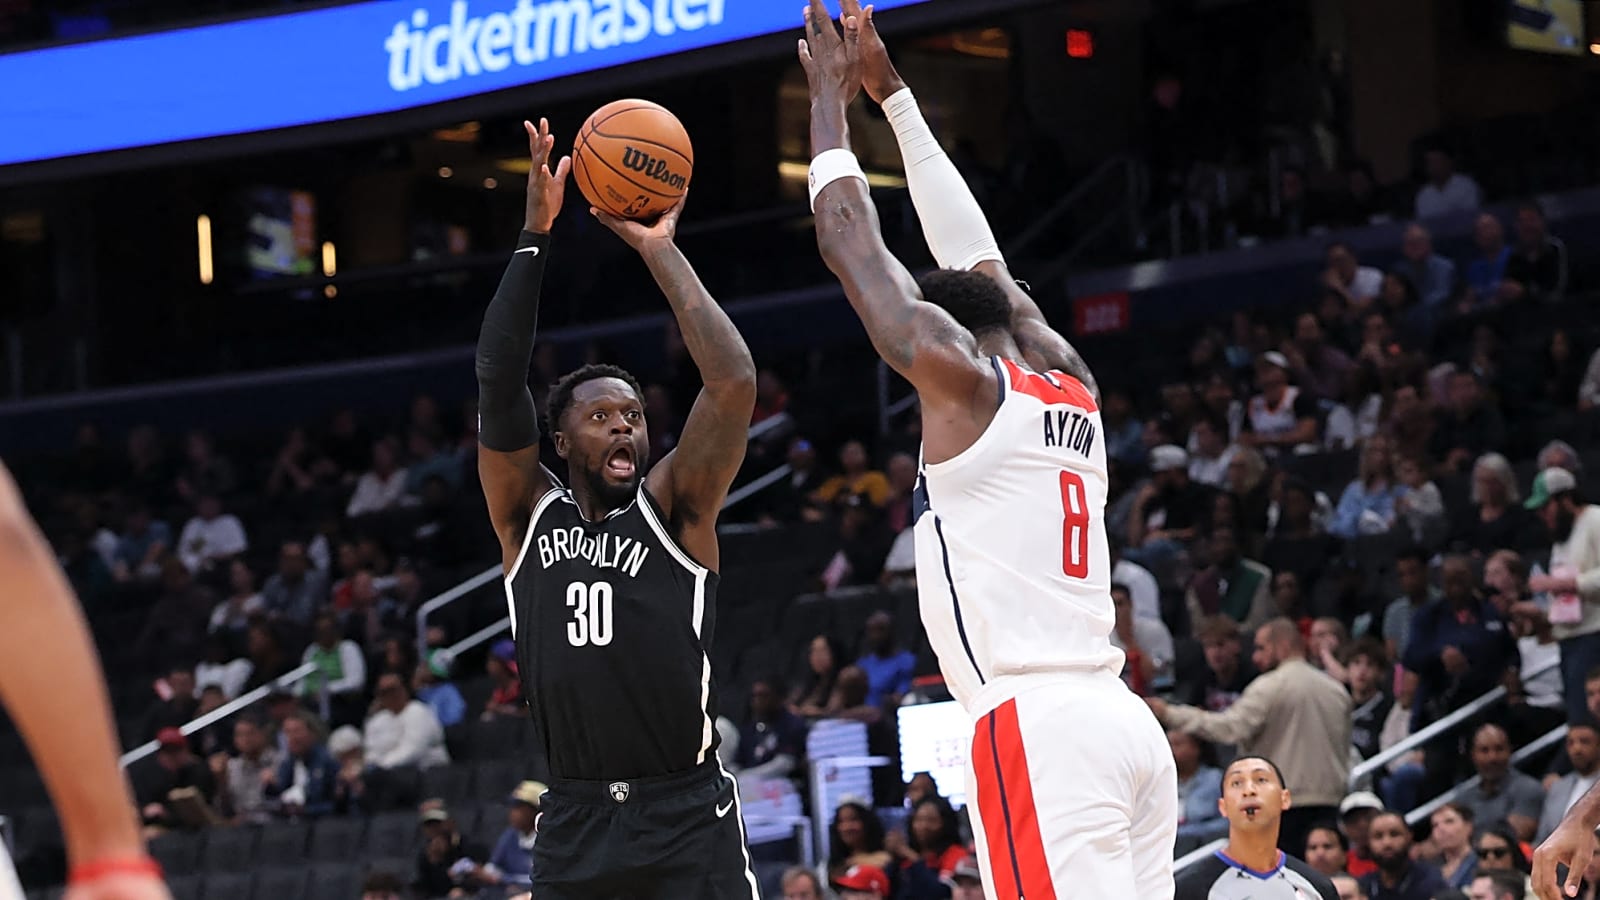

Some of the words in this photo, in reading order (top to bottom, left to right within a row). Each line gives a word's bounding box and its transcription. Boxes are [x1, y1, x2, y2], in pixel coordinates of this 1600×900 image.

[622, 146, 686, 190] Wilson
[1043, 410, 1096, 458] AYTON
[1059, 469, 1090, 579] 8
[537, 526, 649, 578] BROOKLYN
[566, 581, 613, 647] 30
